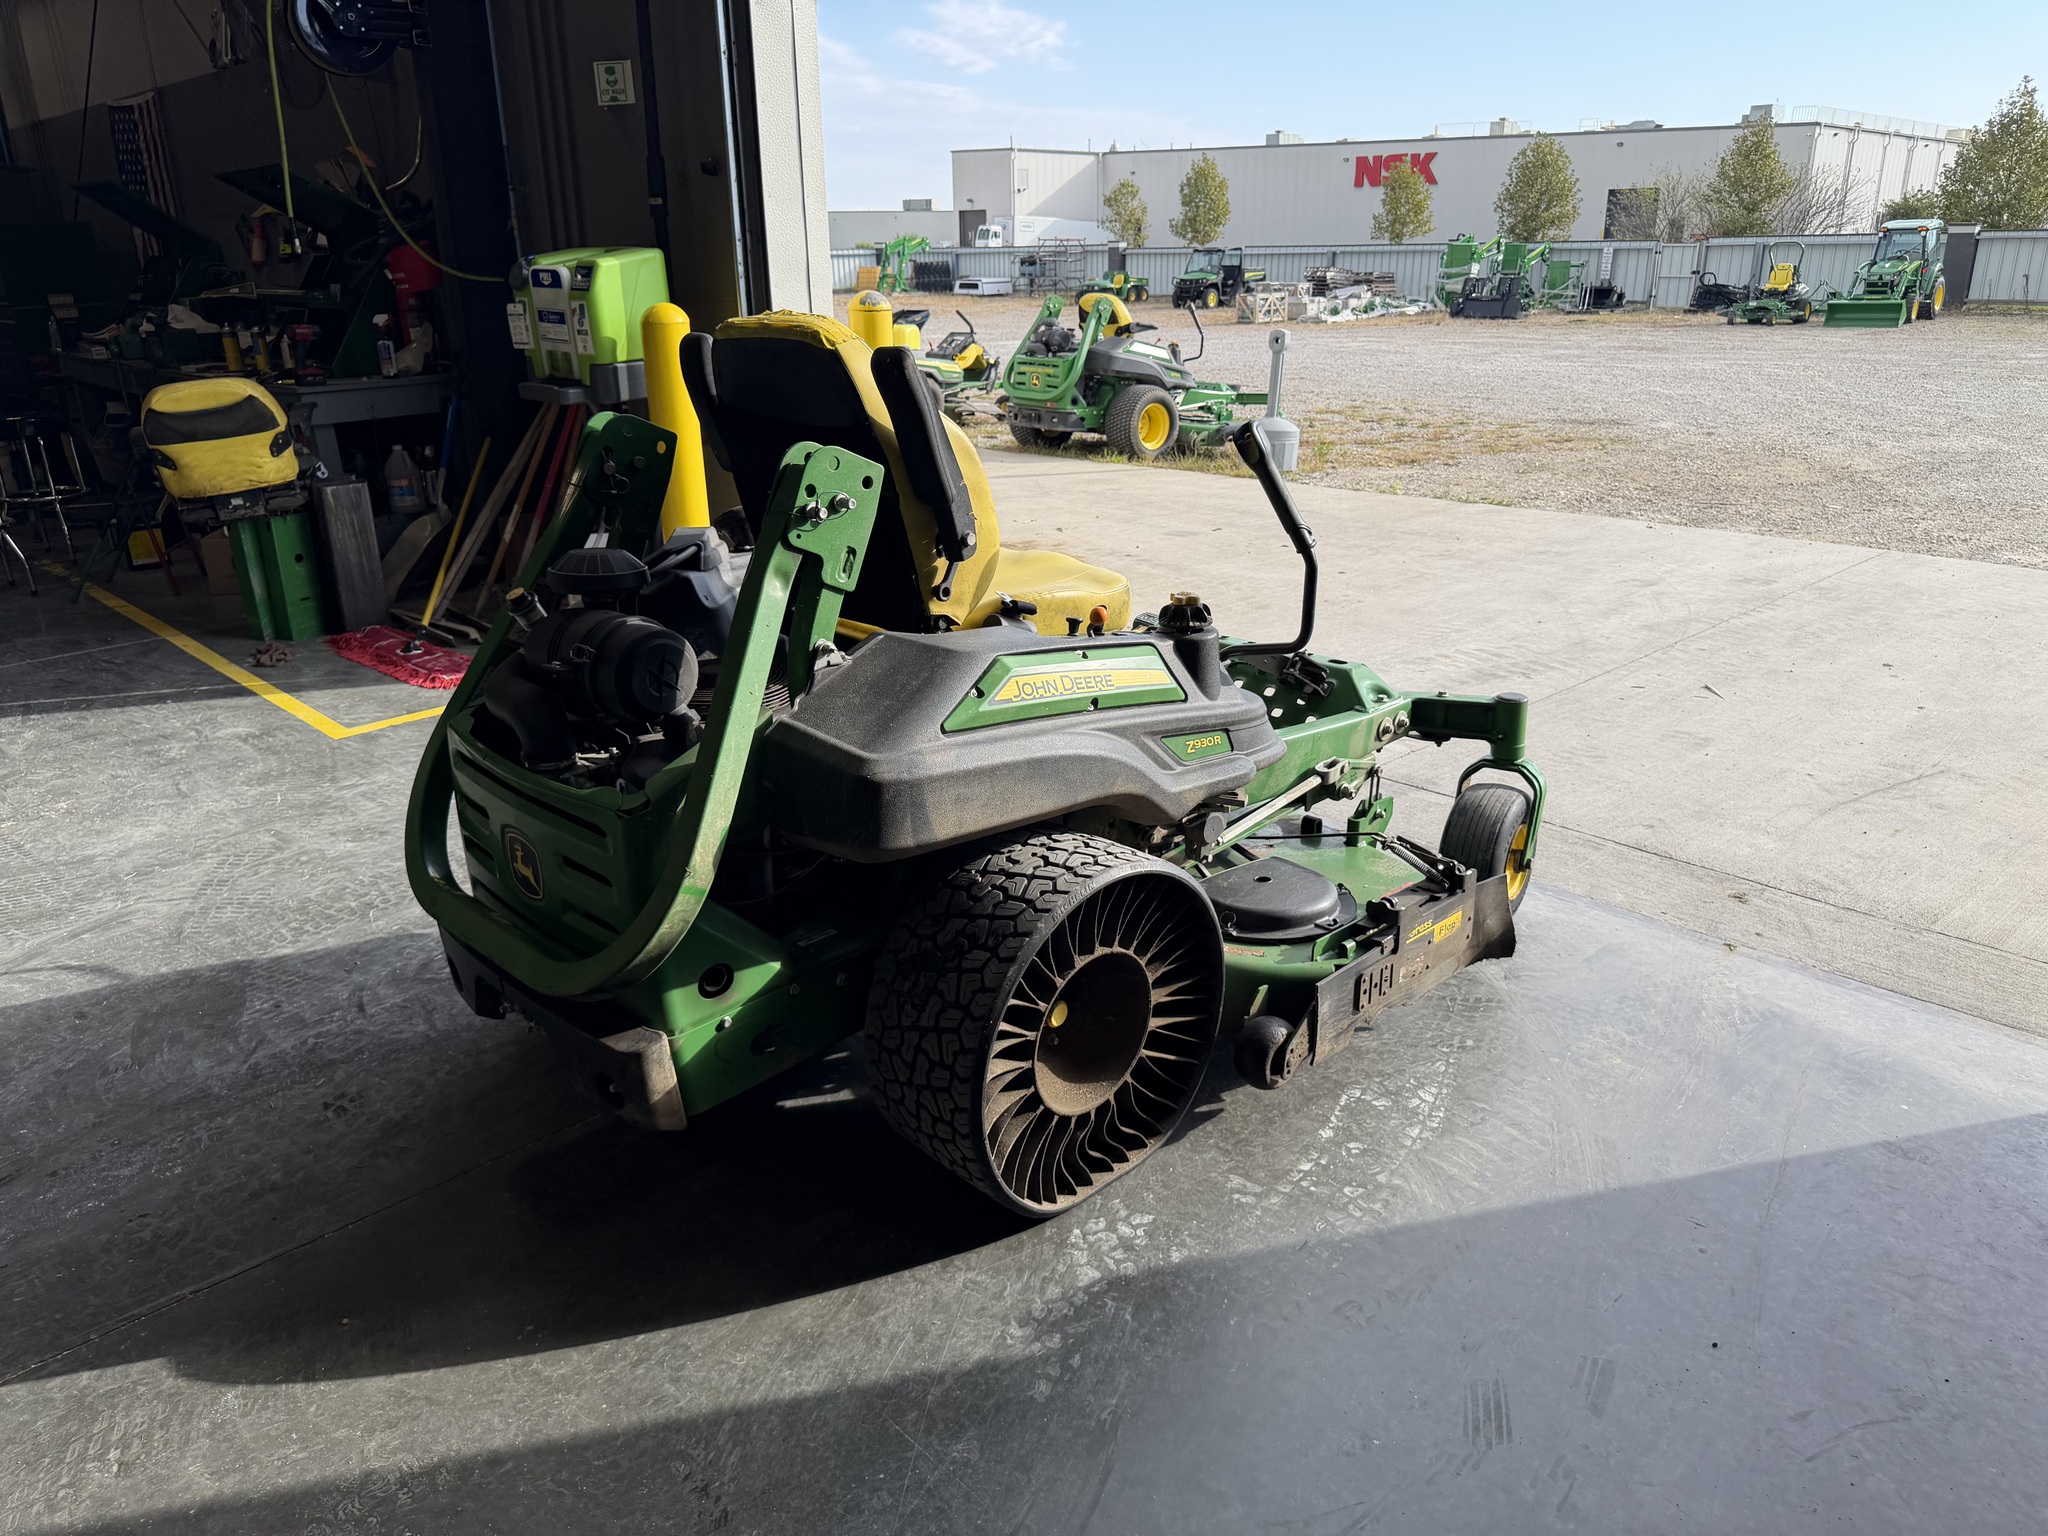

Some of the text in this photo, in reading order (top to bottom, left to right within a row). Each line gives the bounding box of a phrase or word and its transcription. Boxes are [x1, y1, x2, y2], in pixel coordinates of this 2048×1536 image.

[602, 88, 611, 96] EYE
[1353, 151, 1439, 188] NSK
[1013, 674, 1115, 699] JOHN DEERE
[1185, 735, 1222, 754] Z930R
[1051, 880, 1097, 923] MICHELIN
